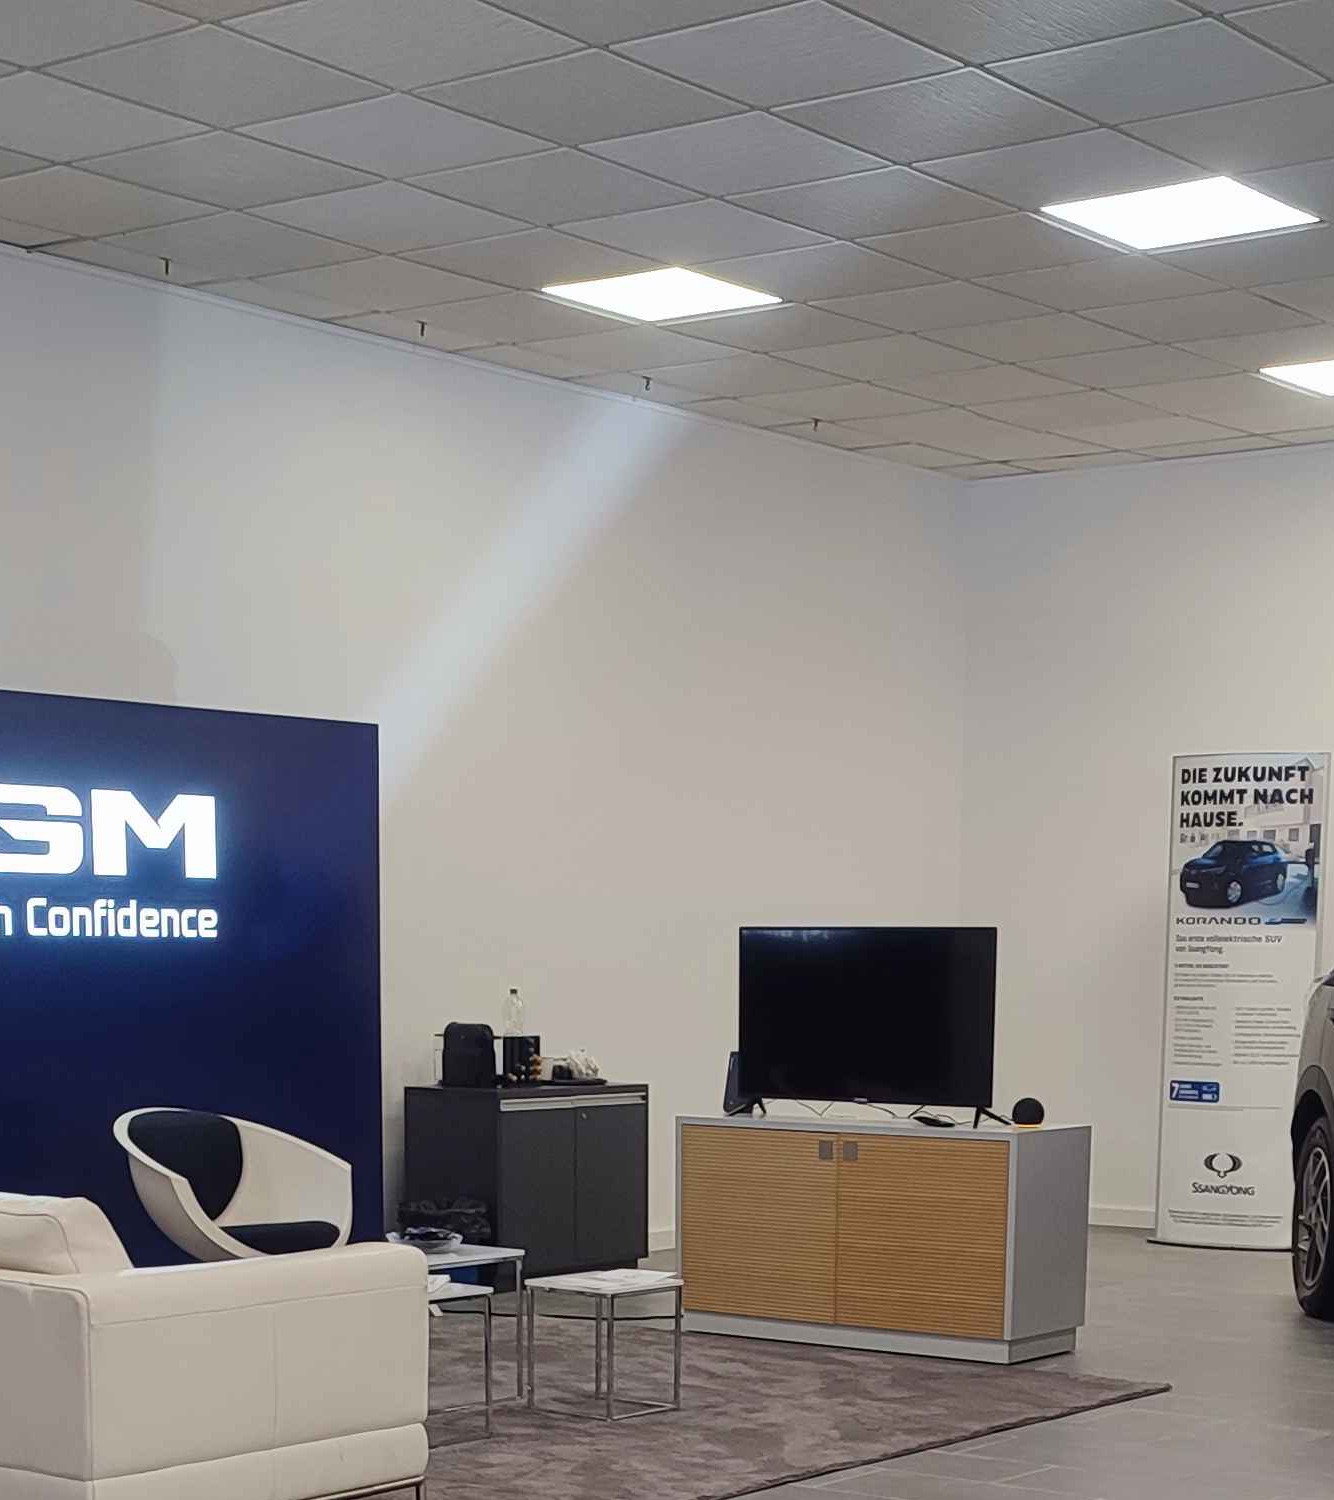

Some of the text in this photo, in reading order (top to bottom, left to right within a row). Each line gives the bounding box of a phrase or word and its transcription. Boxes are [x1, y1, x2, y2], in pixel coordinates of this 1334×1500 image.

[1180, 766, 1310, 784] DIE ZUKUNFT
[1180, 788, 1315, 806] KOMMT NACH
[1179, 810, 1244, 828] HAUSE.
[26, 896, 218, 938] Confidence
[1175, 916, 1262, 926] KORANDO
